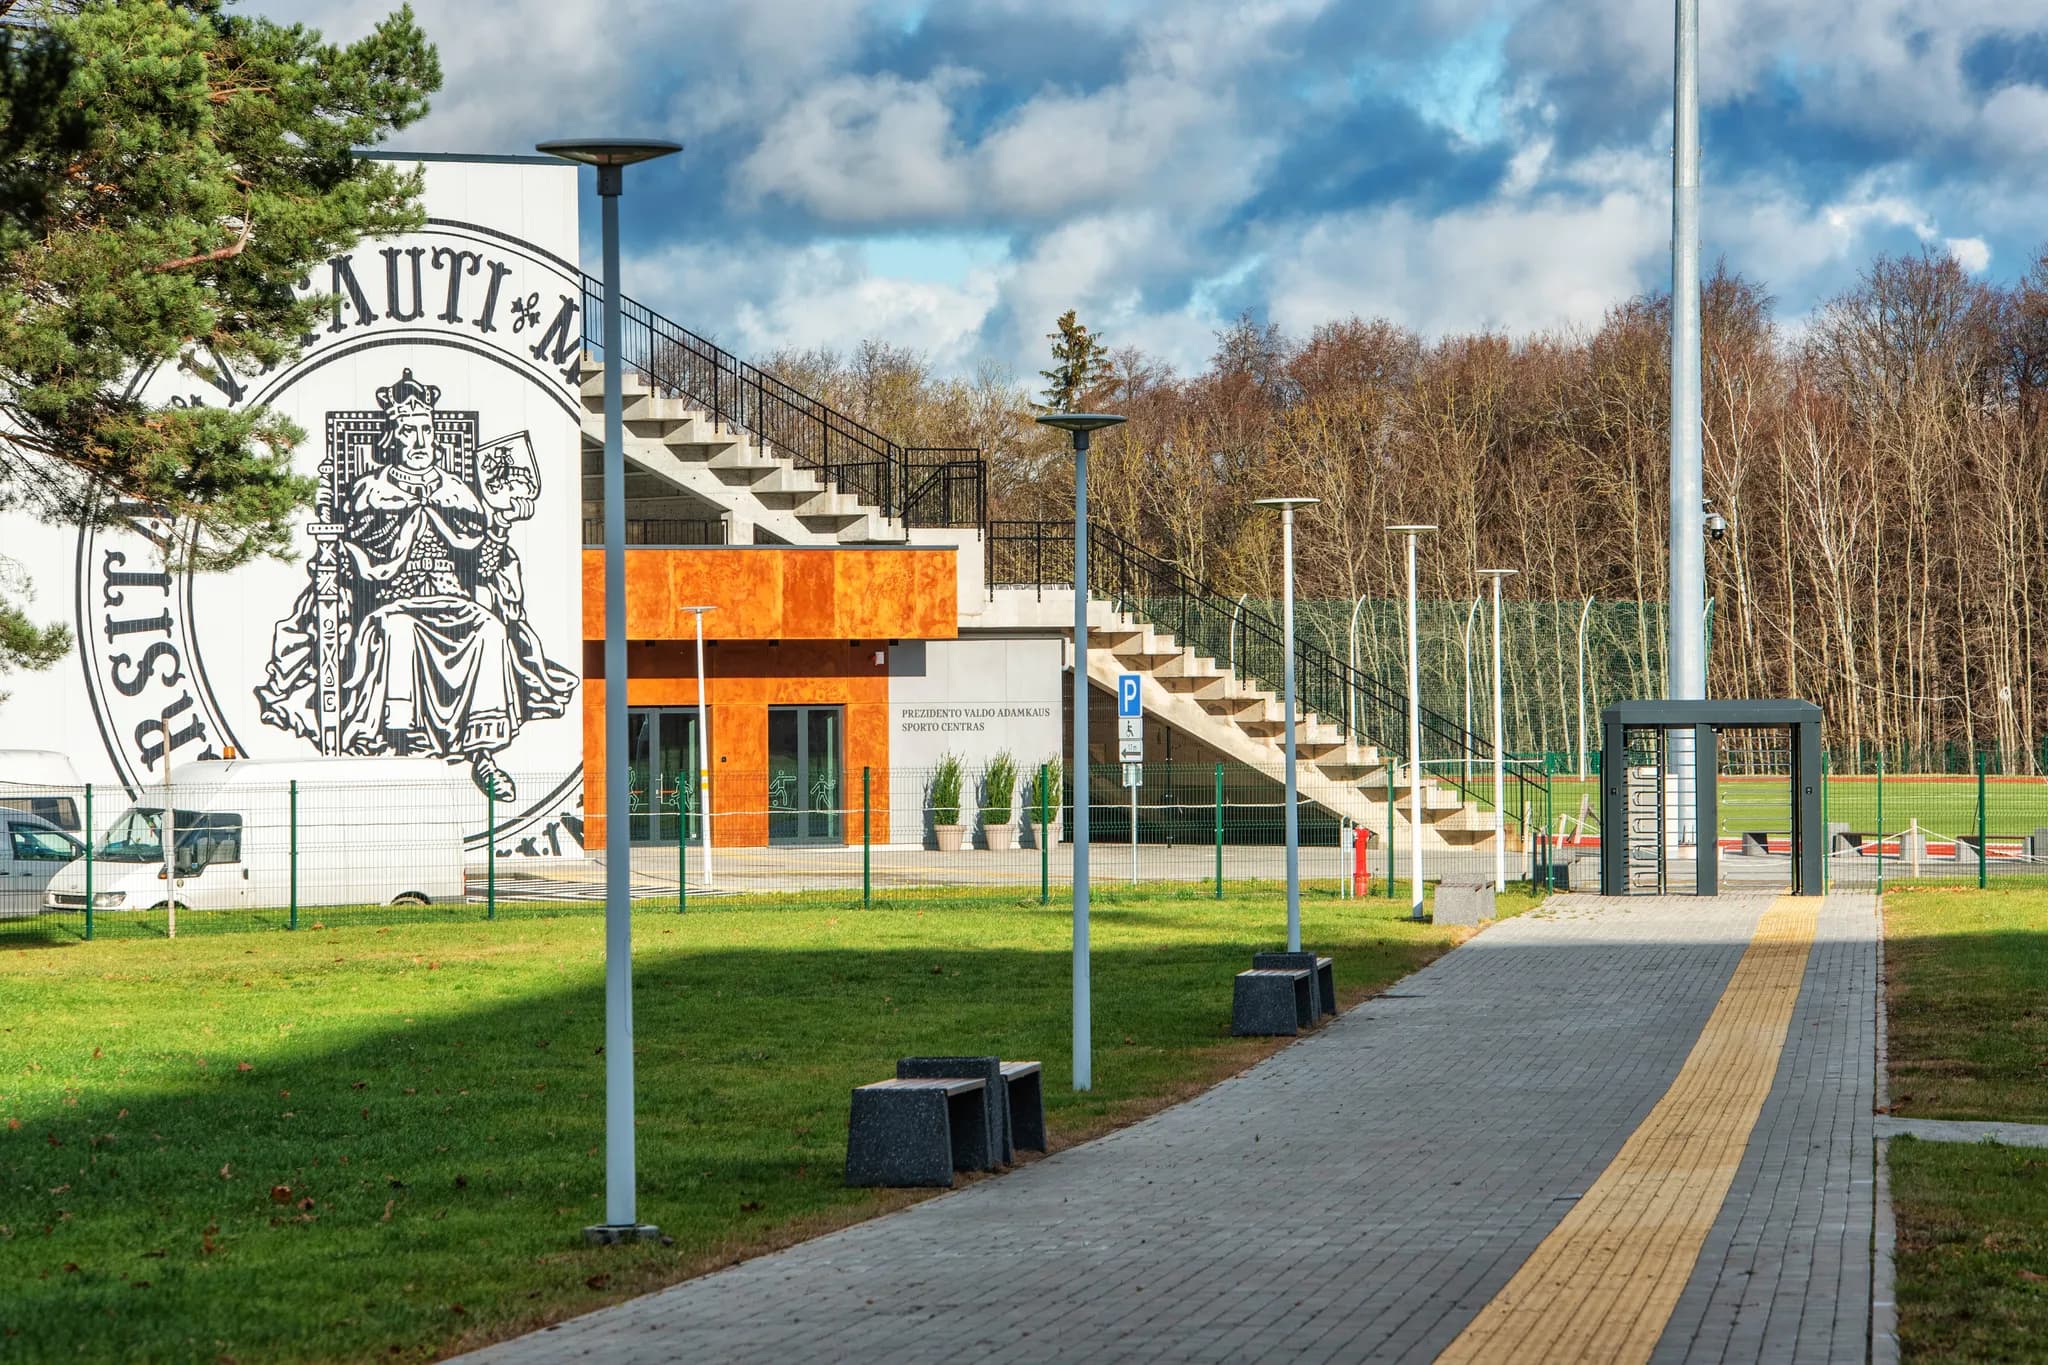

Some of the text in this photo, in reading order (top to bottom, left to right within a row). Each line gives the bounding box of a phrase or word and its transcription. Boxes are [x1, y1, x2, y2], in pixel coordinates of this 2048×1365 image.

[177, 244, 513, 408] VAUTI
[102, 494, 207, 772] RSITA
[902, 707, 1051, 719] PREZIDENTO VALDO ADAMKAUS
[1124, 679, 1137, 713] P
[901, 722, 985, 732] SPORTO CENTRAS
